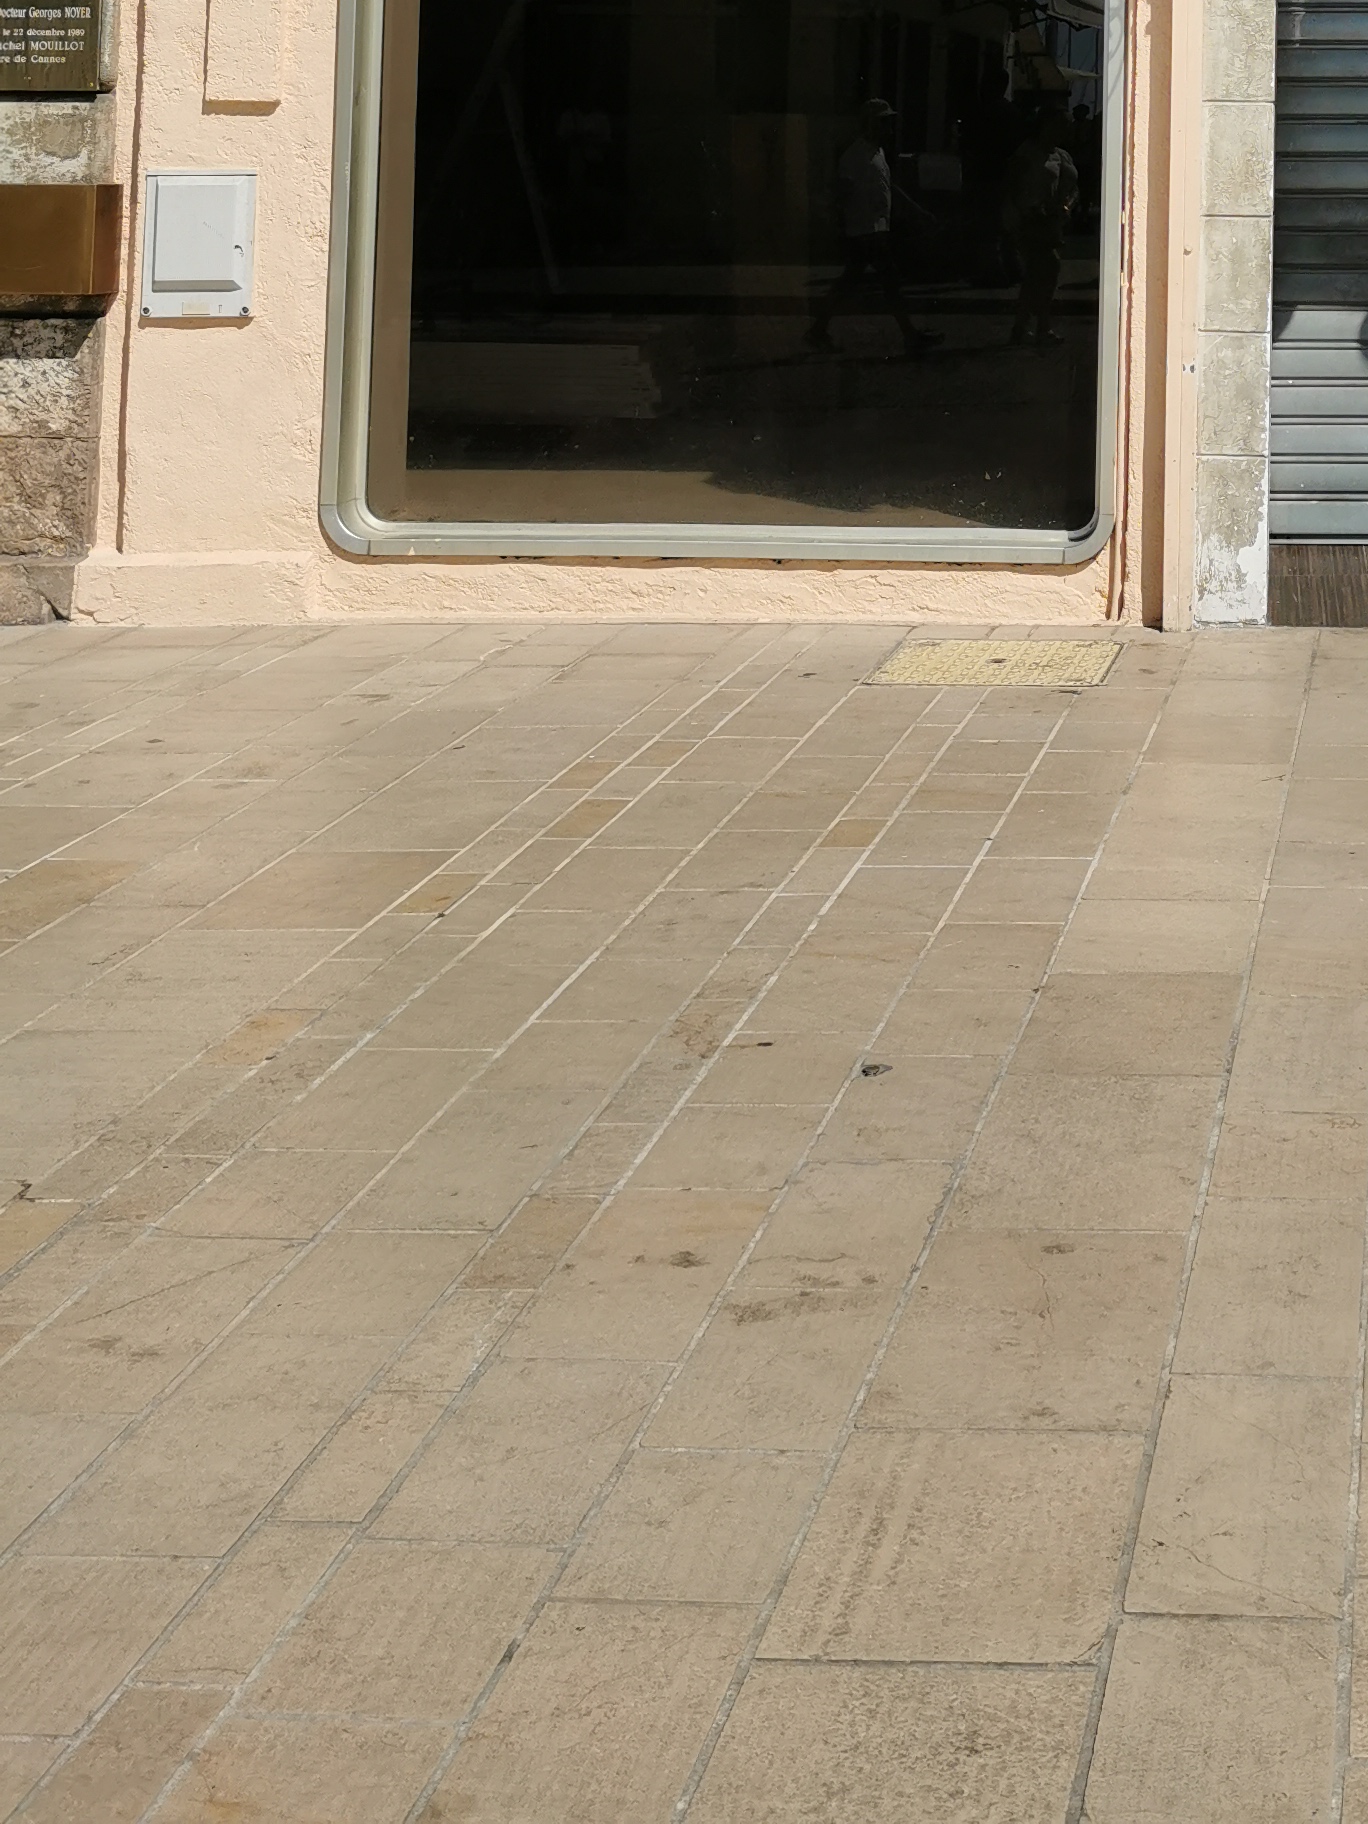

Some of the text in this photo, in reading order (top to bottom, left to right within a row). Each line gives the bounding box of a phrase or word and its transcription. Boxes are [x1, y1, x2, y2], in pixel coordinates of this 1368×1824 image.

[29, 7, 61, 20] Georges
[65, 7, 91, 18] NOYER
[13, 28, 24, 36] 22
[68, 28, 85, 36] 1989
[30, 41, 85, 51] MOUILLOT
[13, 54, 27, 63] de
[31, 55, 66, 63] Cannes
